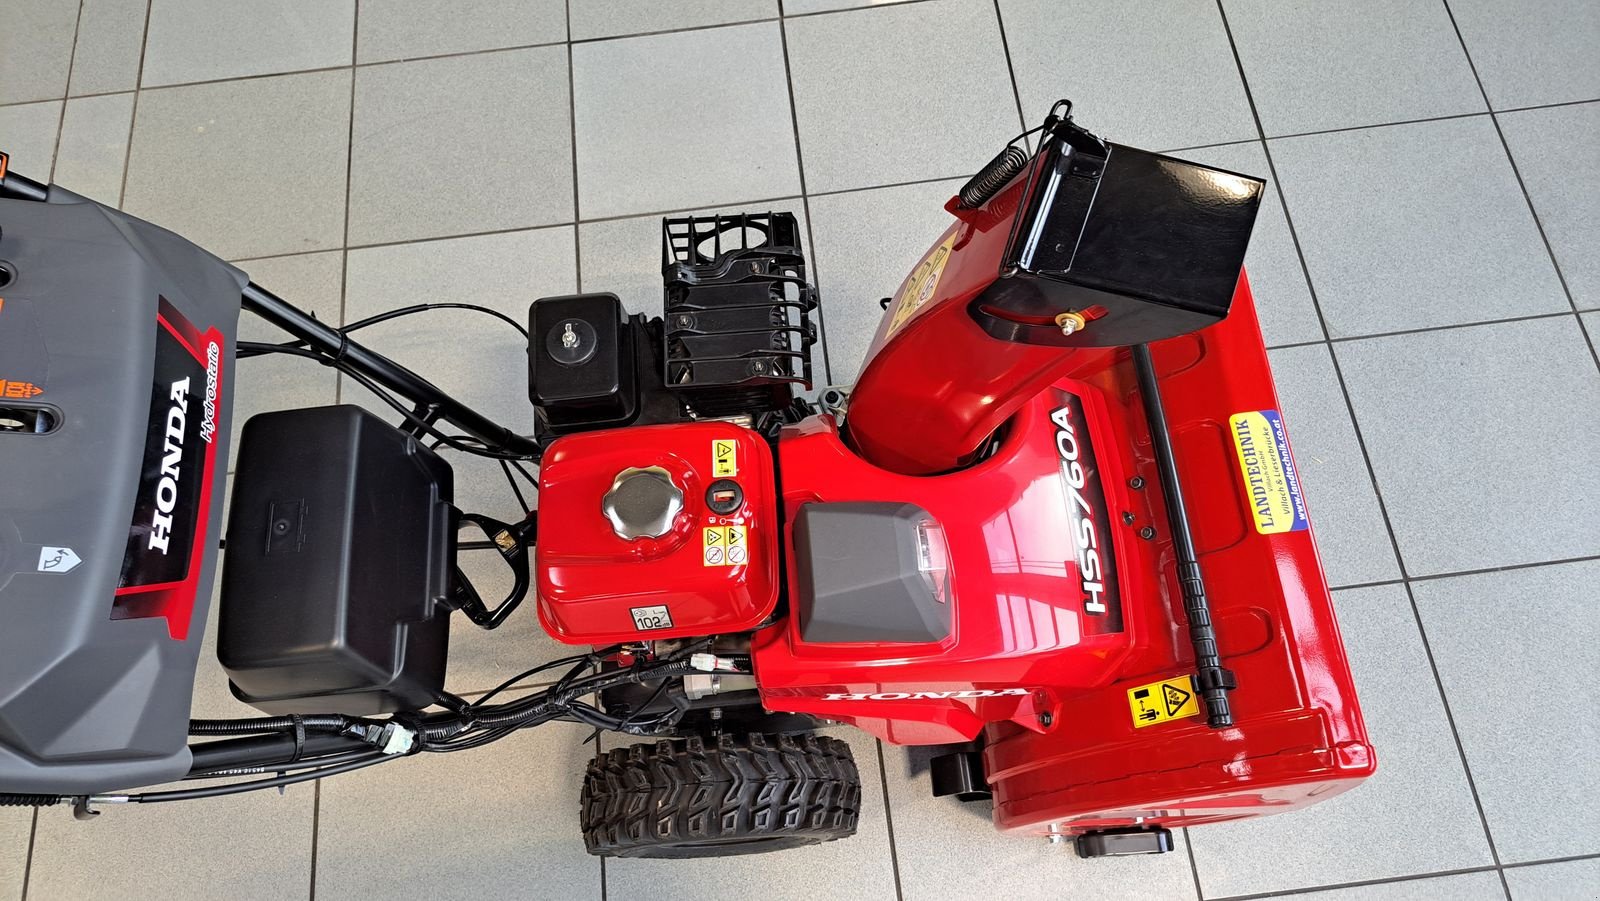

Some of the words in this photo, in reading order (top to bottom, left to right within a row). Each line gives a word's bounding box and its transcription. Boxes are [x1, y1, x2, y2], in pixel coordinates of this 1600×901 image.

[200, 341, 220, 443] Hydrostatic
[148, 376, 191, 556] HONDA
[1235, 418, 1275, 528] LANDTECHNIK
[1259, 450, 1269, 471] GmbH
[1264, 471, 1273, 492] Villach
[1272, 418, 1306, 521] www.landtechnik.co.at
[1050, 406, 1106, 614] HSS760A
[1278, 488, 1290, 515] Villach
[637, 616, 662, 629] 102
[821, 687, 1033, 701] HONDA
